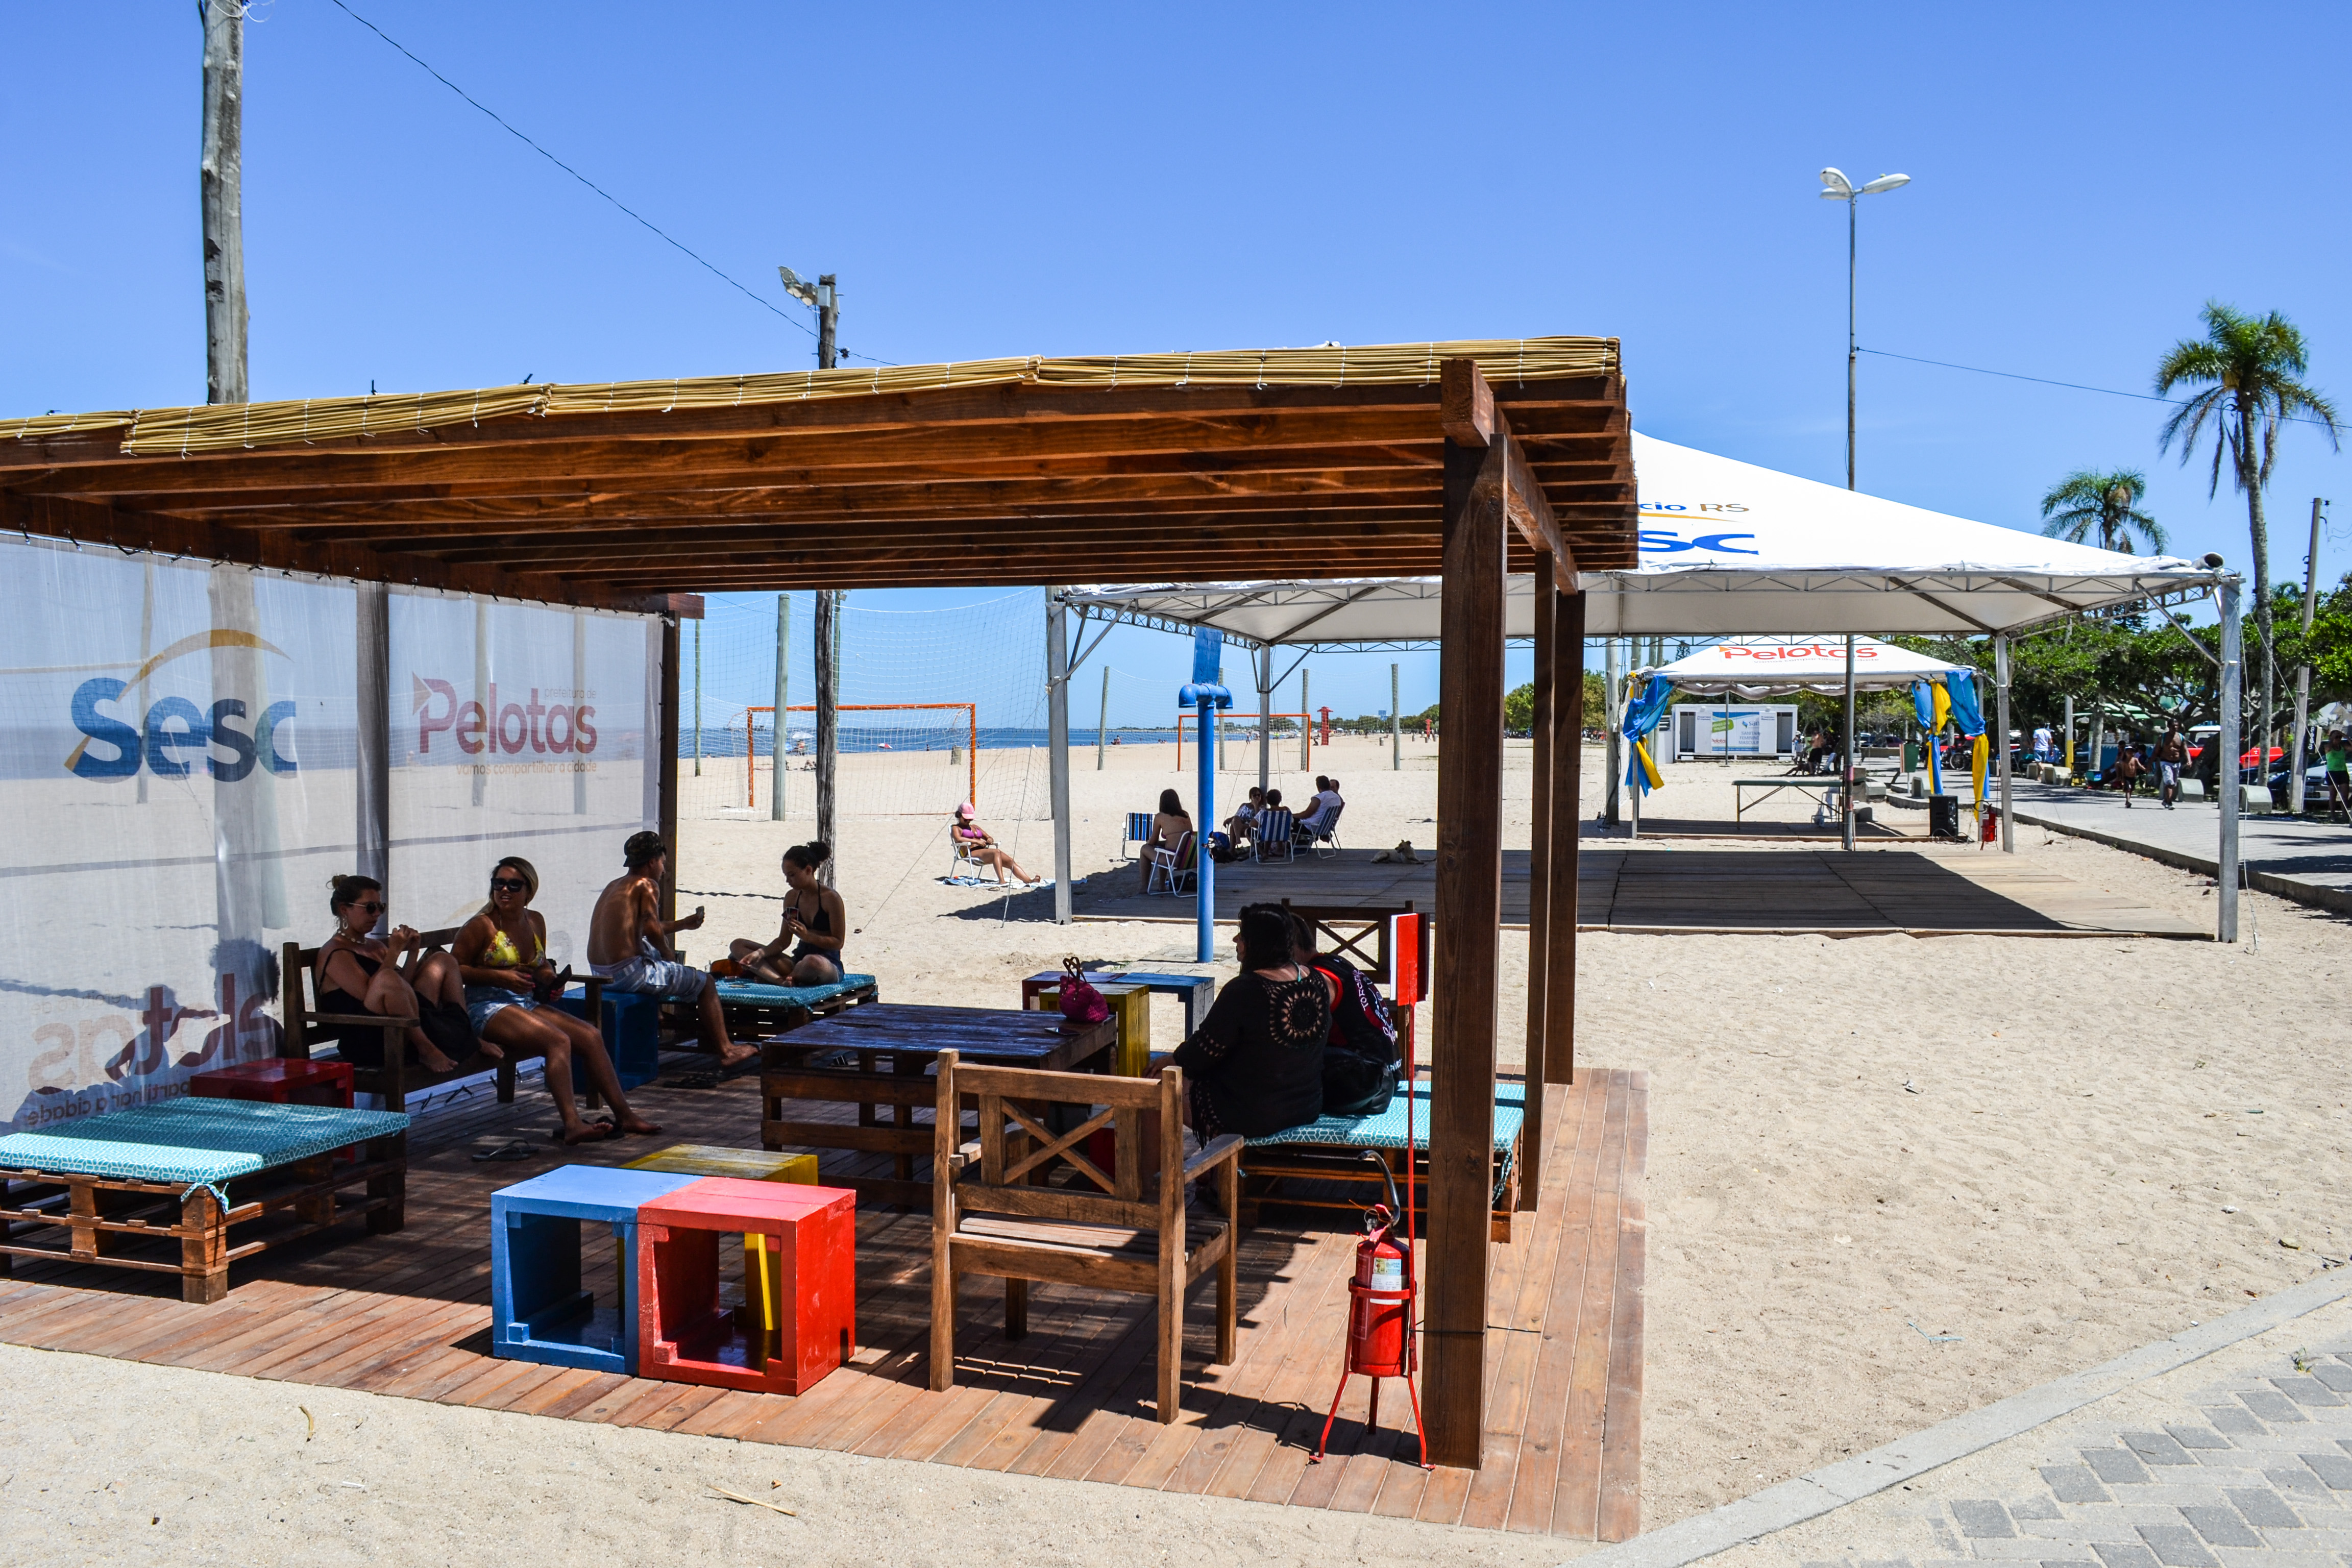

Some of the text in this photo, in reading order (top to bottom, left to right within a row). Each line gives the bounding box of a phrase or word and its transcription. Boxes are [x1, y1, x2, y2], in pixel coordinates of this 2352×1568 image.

[1639, 502, 1750, 512] cio RS
[1638, 530, 1759, 555] sc
[1723, 645, 1878, 659] Pelotas
[545, 686, 597, 699] prefeitura de
[420, 678, 597, 754] Pelotas
[71, 677, 298, 784] Sesc
[494, 761, 557, 777] compartilhar
[559, 764, 566, 773] a
[567, 760, 597, 773] cidade
